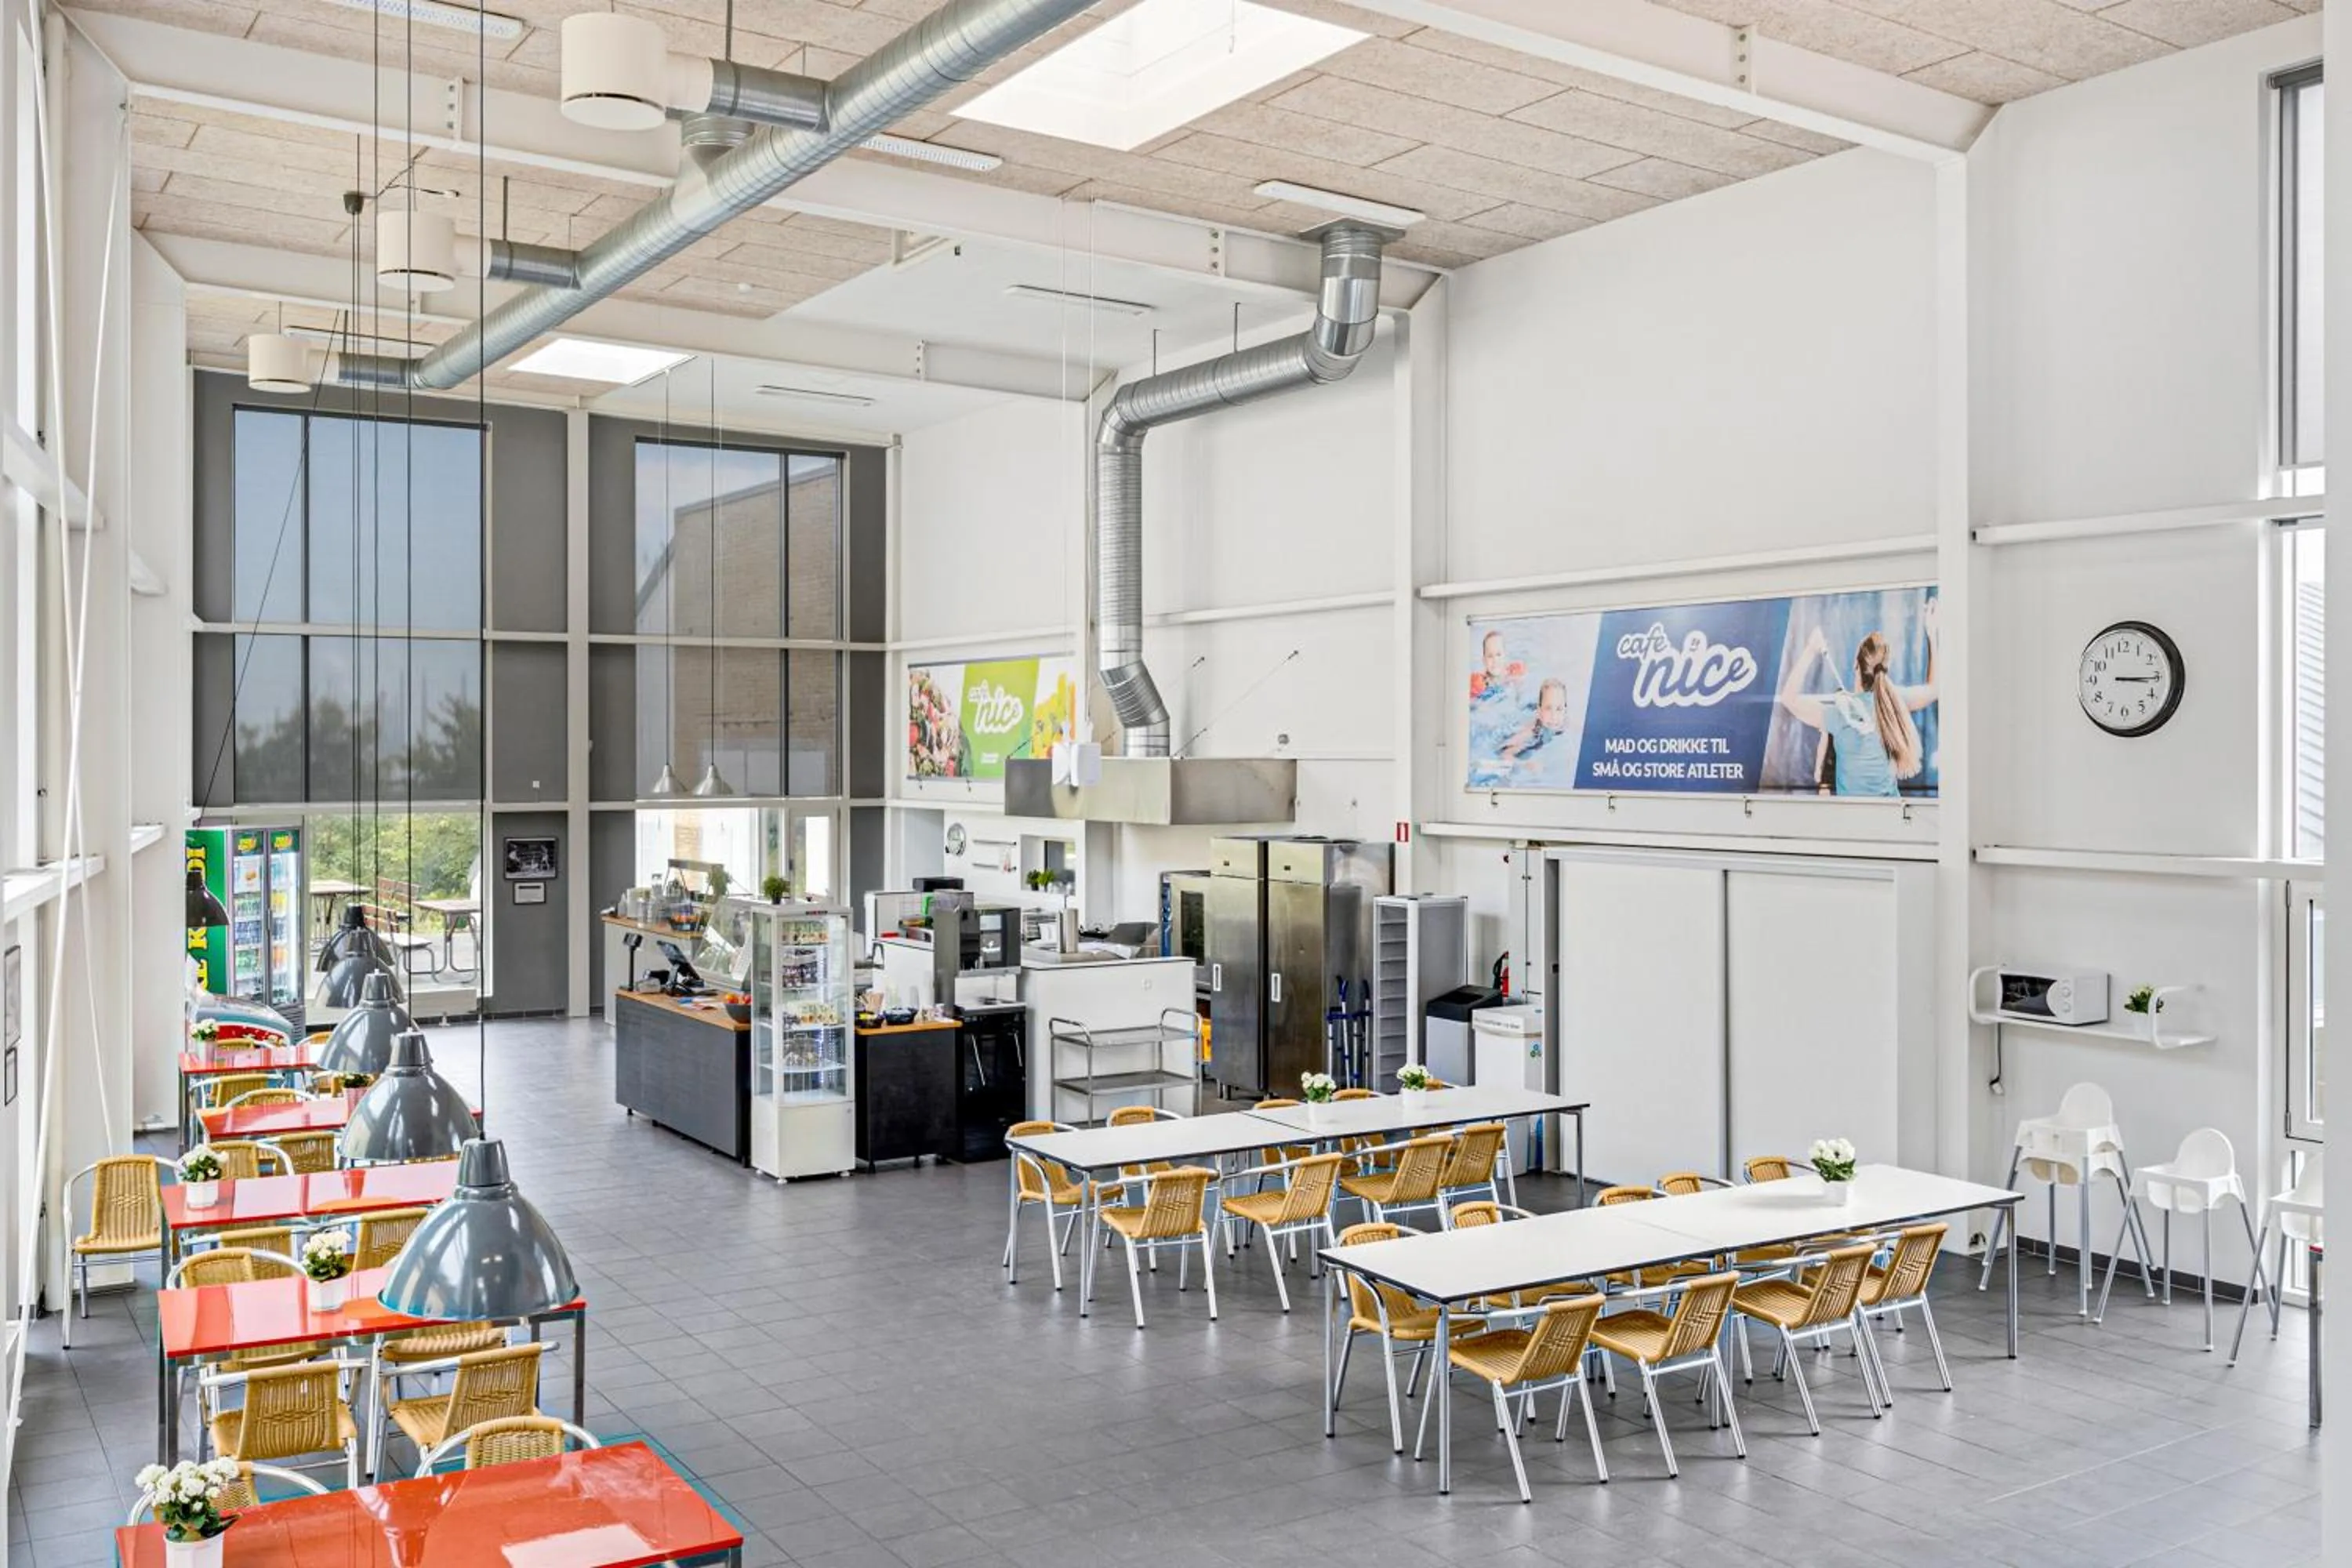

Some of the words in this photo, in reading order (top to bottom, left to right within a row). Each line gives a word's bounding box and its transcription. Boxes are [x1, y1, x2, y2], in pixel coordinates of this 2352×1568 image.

[2105, 645, 2114, 659] 11
[2118, 641, 2130, 653] 12
[2146, 653, 2154, 666] 2
[1636, 632, 1754, 704] nice
[2094, 660, 2107, 673] 10
[2089, 674, 2098, 686] 9
[2154, 670, 2161, 683] 3
[2094, 690, 2103, 703] 8
[2146, 687, 2155, 699] 4
[2107, 702, 2114, 713] 7
[2120, 706, 2129, 717] 6
[2138, 700, 2147, 714] 5
[1605, 738, 1635, 753] MAD
[1637, 738, 1657, 753] OG
[1659, 738, 1708, 754] DRIKKE
[1710, 738, 1730, 753] TIL
[1592, 758, 1621, 778] SMÅ
[1622, 762, 1642, 778] OG
[1643, 762, 1685, 779] STORE
[1686, 763, 1744, 779] ATLETER
